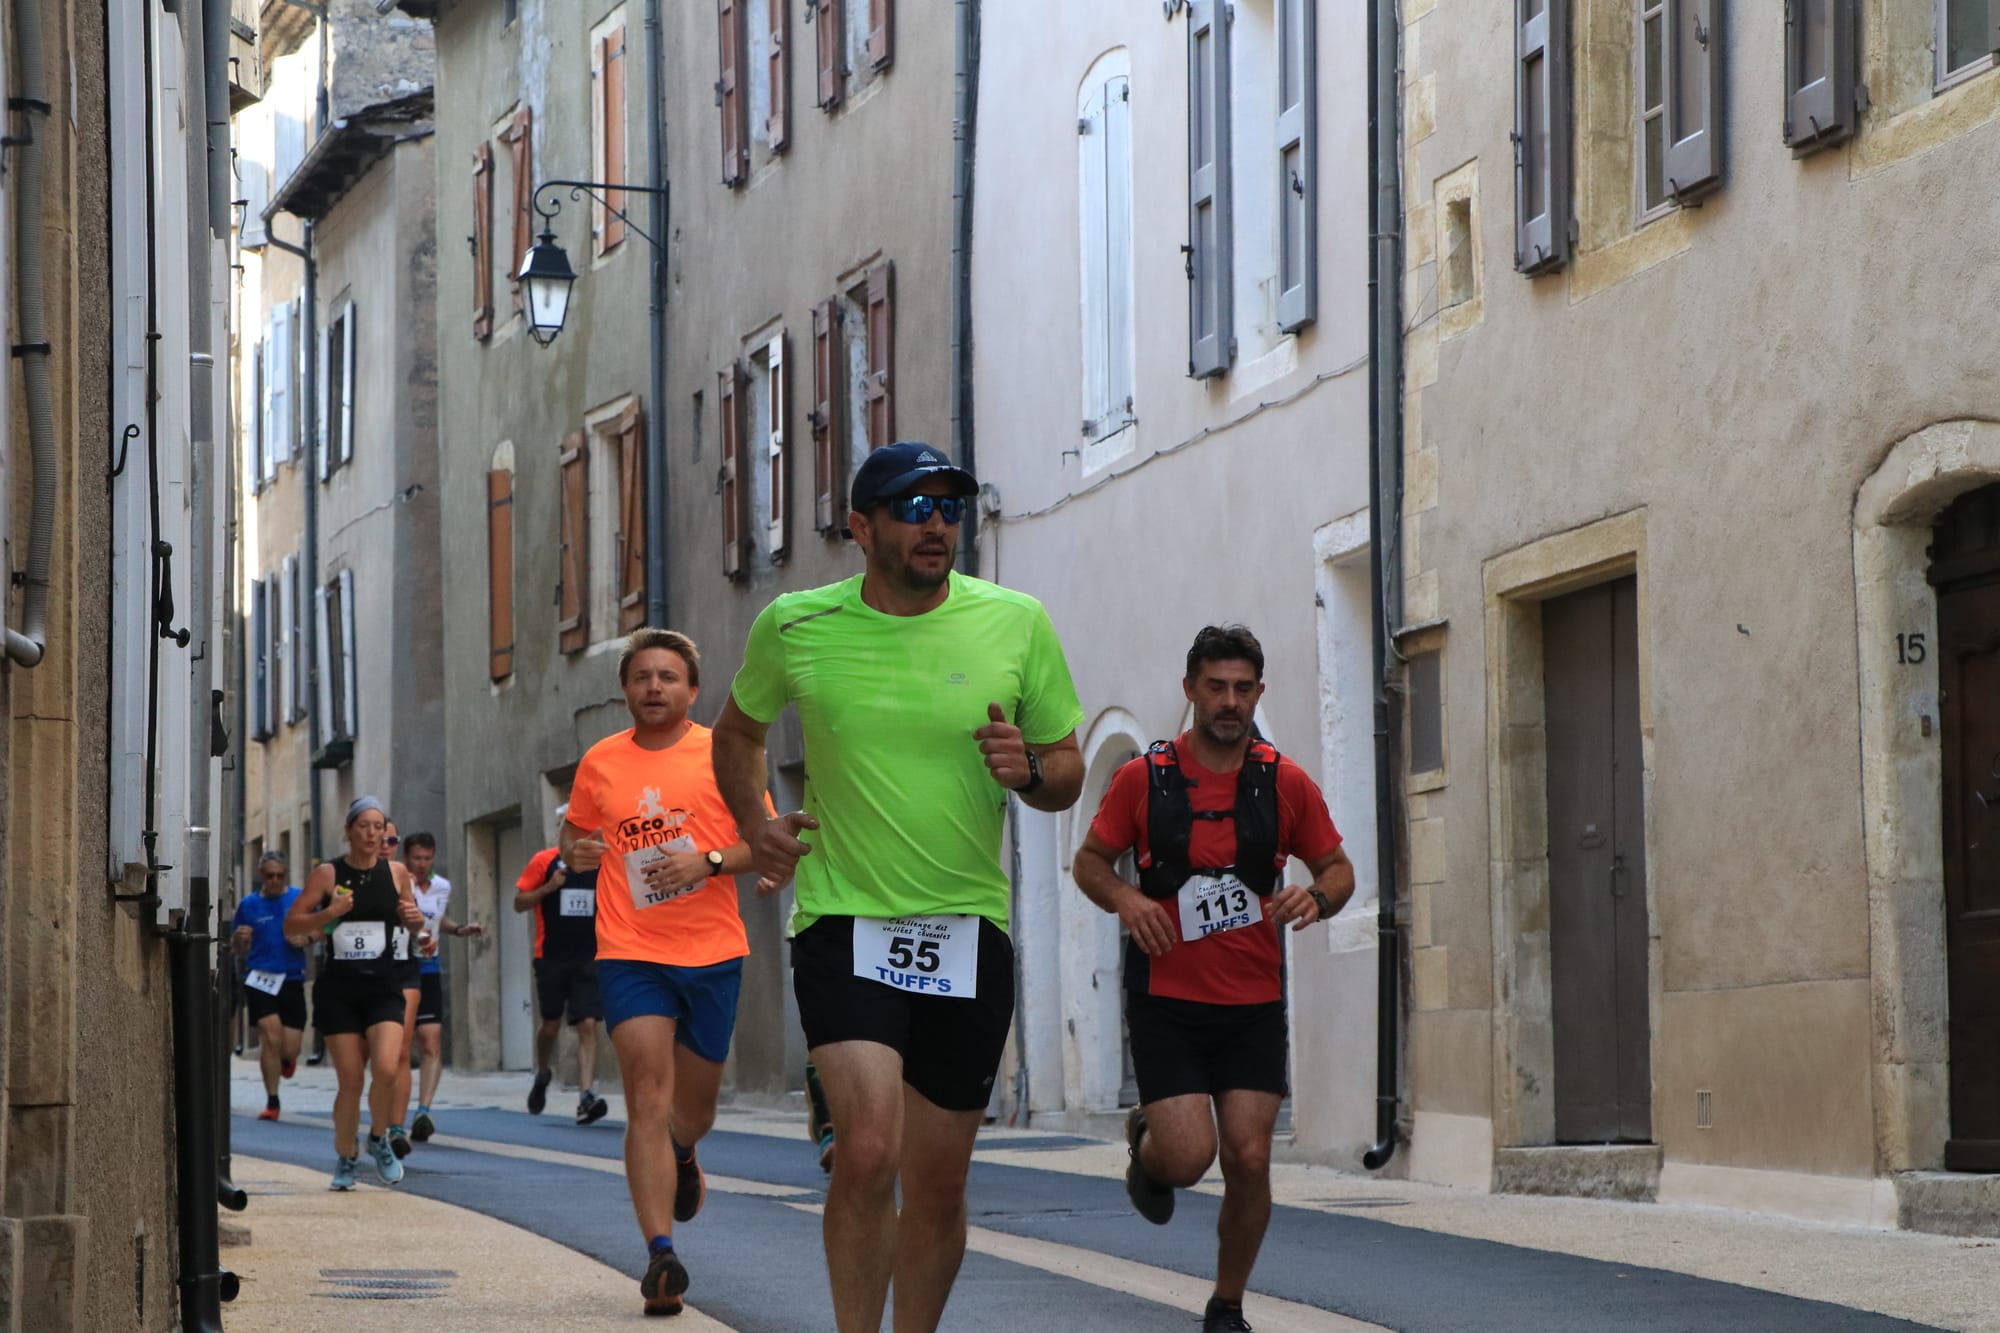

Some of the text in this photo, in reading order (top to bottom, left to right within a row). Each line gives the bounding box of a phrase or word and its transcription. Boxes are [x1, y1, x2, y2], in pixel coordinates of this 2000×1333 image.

[1896, 633, 1926, 664] 15
[623, 813, 687, 838] LE COUP
[1196, 889, 1248, 921] 113
[889, 916, 948, 932] Challenge des
[1199, 913, 1250, 935] TUFF'S
[354, 937, 365, 950] 8
[888, 936, 940, 973] 55
[875, 966, 952, 992] TUFF'S
